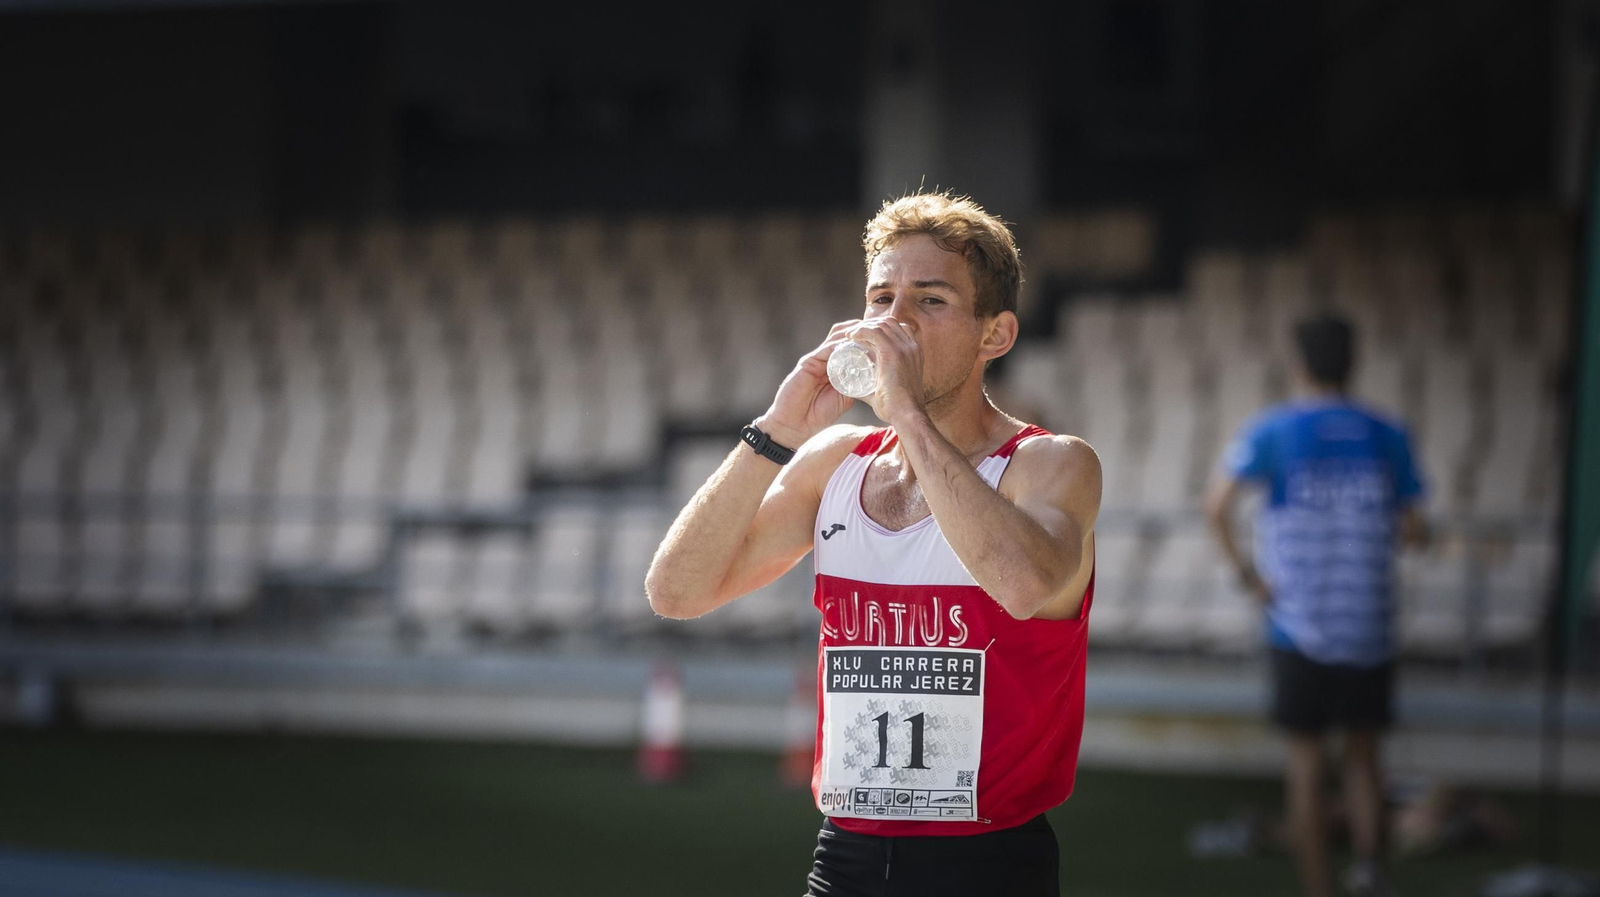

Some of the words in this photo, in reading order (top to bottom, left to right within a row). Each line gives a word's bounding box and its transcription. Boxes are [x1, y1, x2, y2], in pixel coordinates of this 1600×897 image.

[822, 591, 969, 647] CURTIUS
[832, 656, 862, 671] XLV
[880, 656, 975, 673] CARRERA
[832, 674, 903, 689] POPULAR
[910, 675, 974, 691] JEREZ
[871, 711, 932, 770] 11
[821, 787, 854, 812] enjoy!
